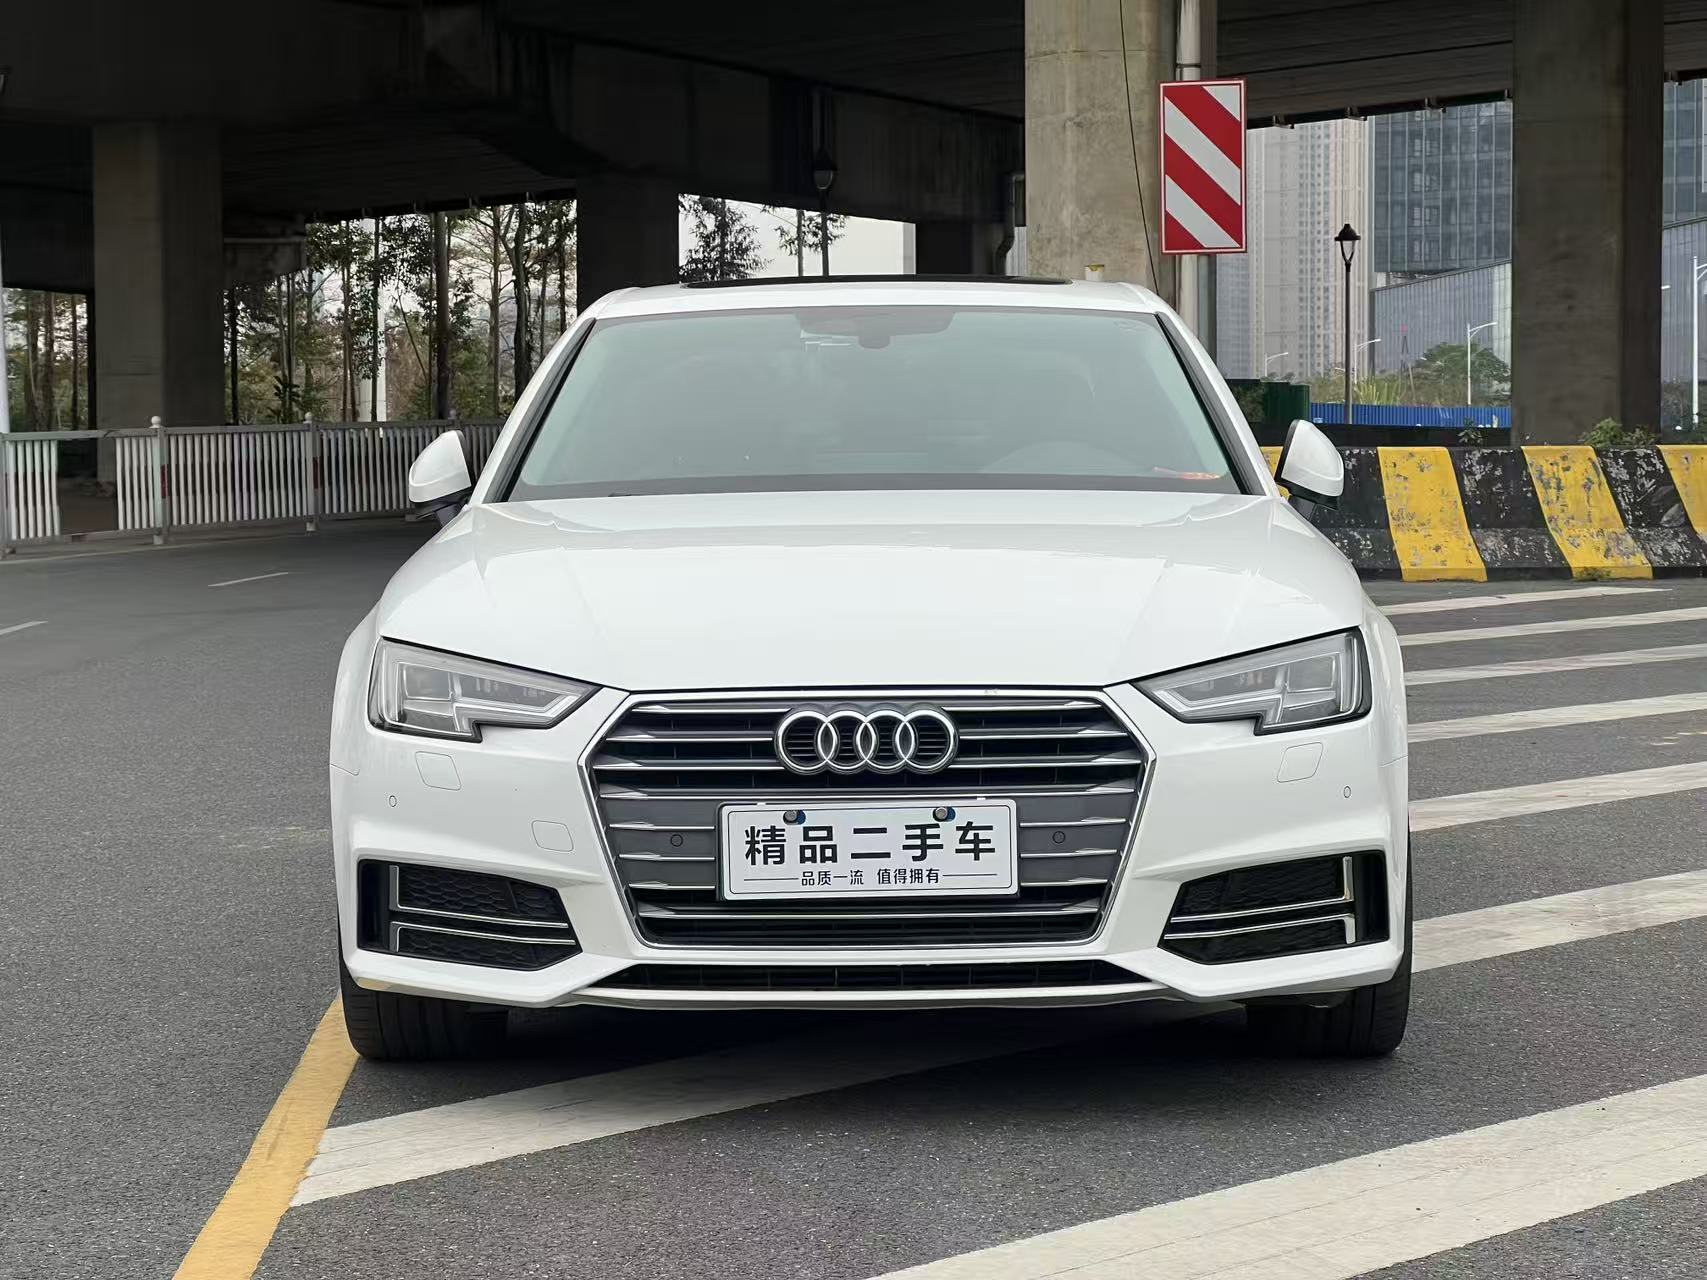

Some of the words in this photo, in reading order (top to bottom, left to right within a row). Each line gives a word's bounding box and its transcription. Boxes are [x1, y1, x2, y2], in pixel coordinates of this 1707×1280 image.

[744, 821, 996, 866] 精品二手车
[801, 869, 865, 886] 品质一流
[877, 868, 940, 885] 值得拥有
